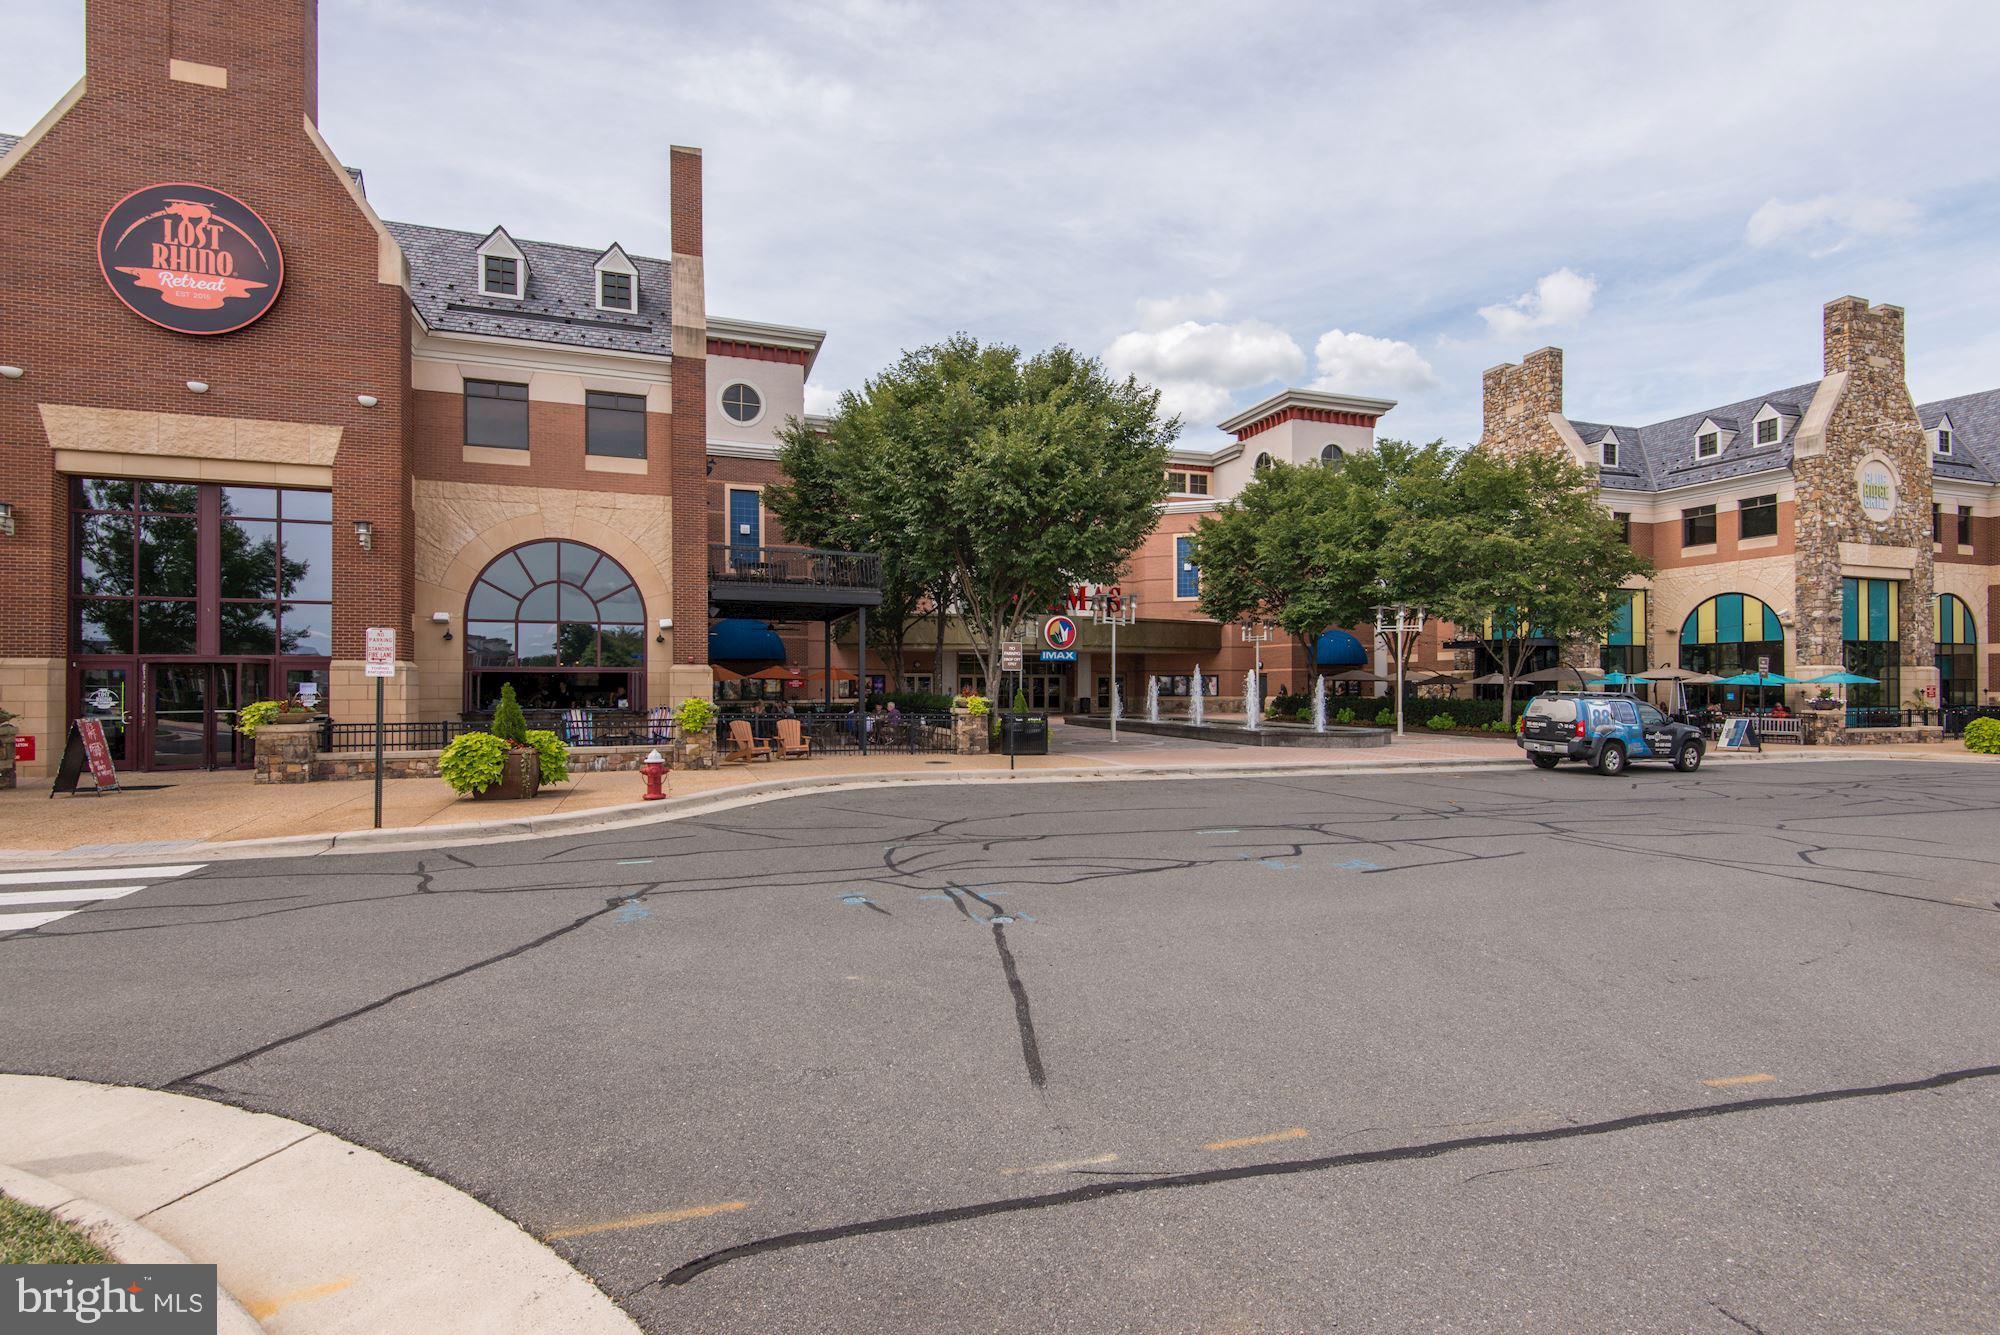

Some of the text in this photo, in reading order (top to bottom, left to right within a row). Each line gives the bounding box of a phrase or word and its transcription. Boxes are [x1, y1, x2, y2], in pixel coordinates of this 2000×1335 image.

[163, 218, 224, 250] LOST
[151, 242, 234, 277] RHINO
[158, 271, 227, 293] Retreat
[1042, 651, 1074, 660] IMAX
